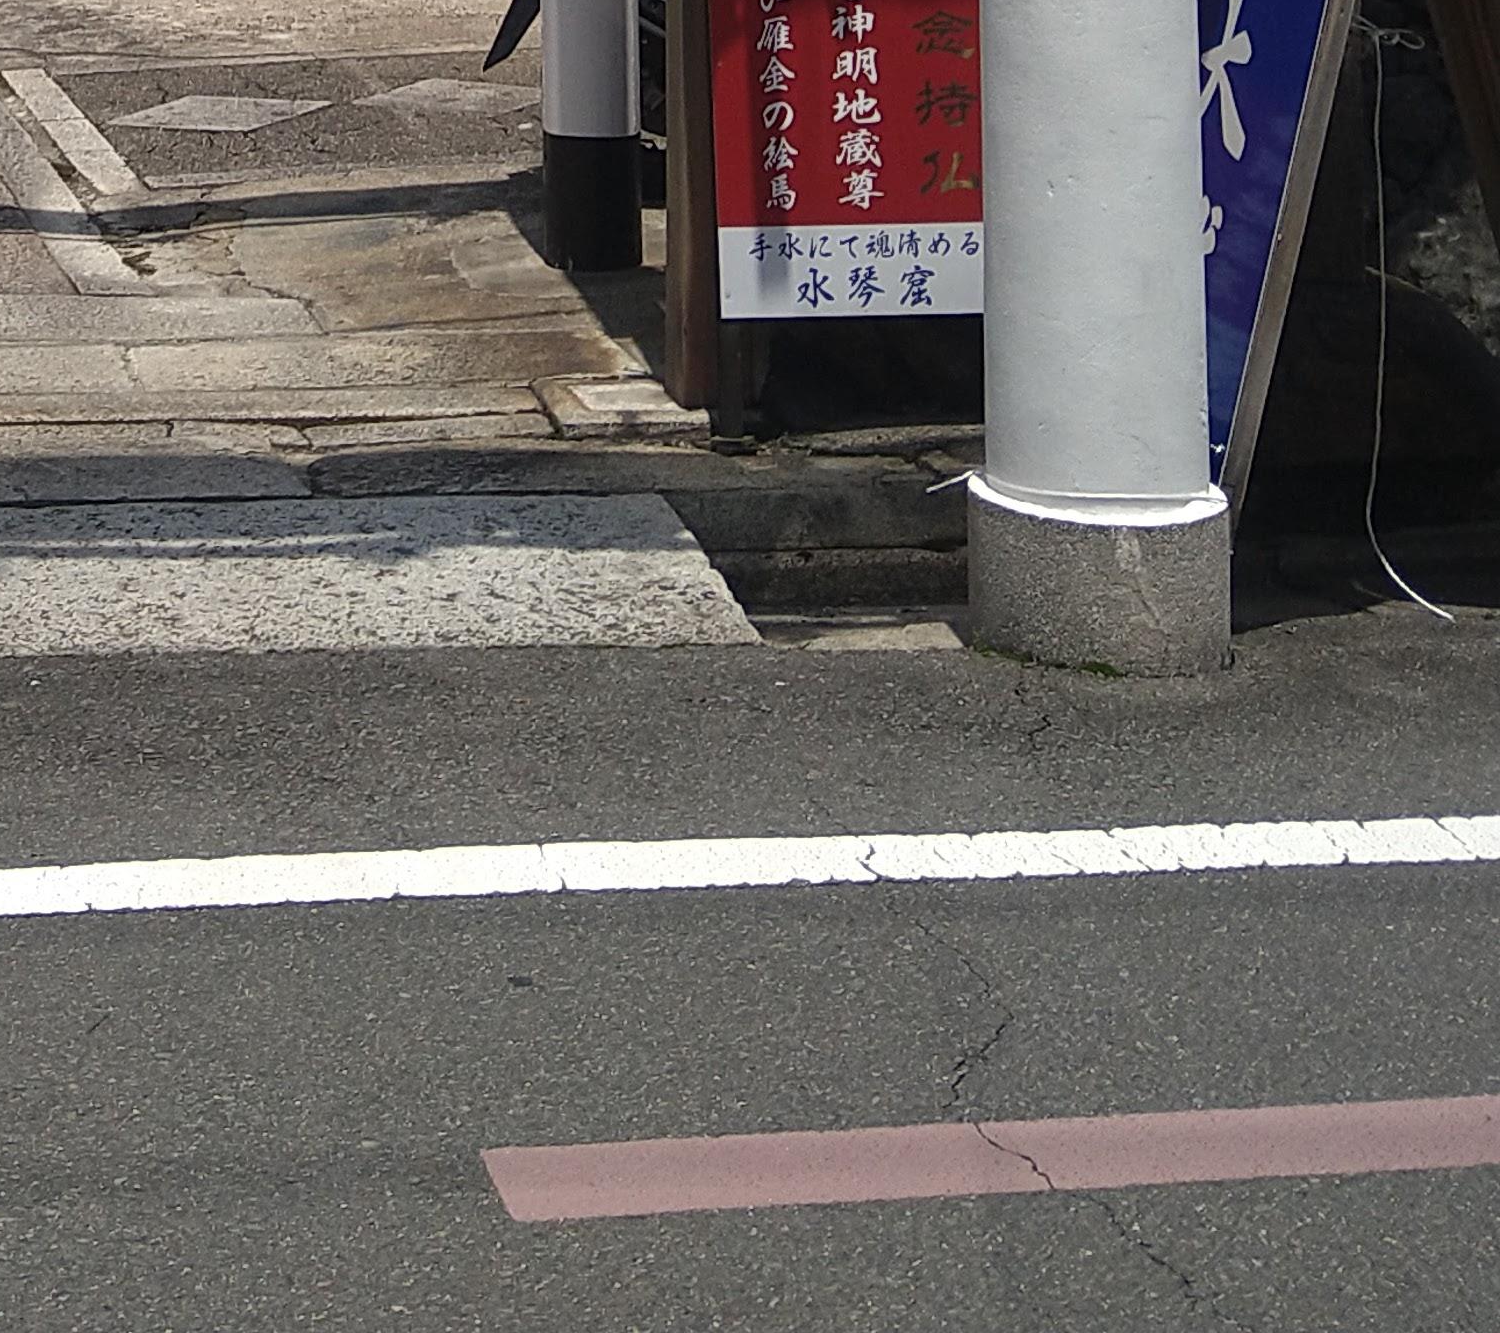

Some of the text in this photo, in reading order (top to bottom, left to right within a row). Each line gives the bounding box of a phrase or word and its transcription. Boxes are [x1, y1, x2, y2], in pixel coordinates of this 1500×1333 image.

[749, 229, 980, 261] 手水にて魂清める
[798, 265, 935, 308] 水琴窟
